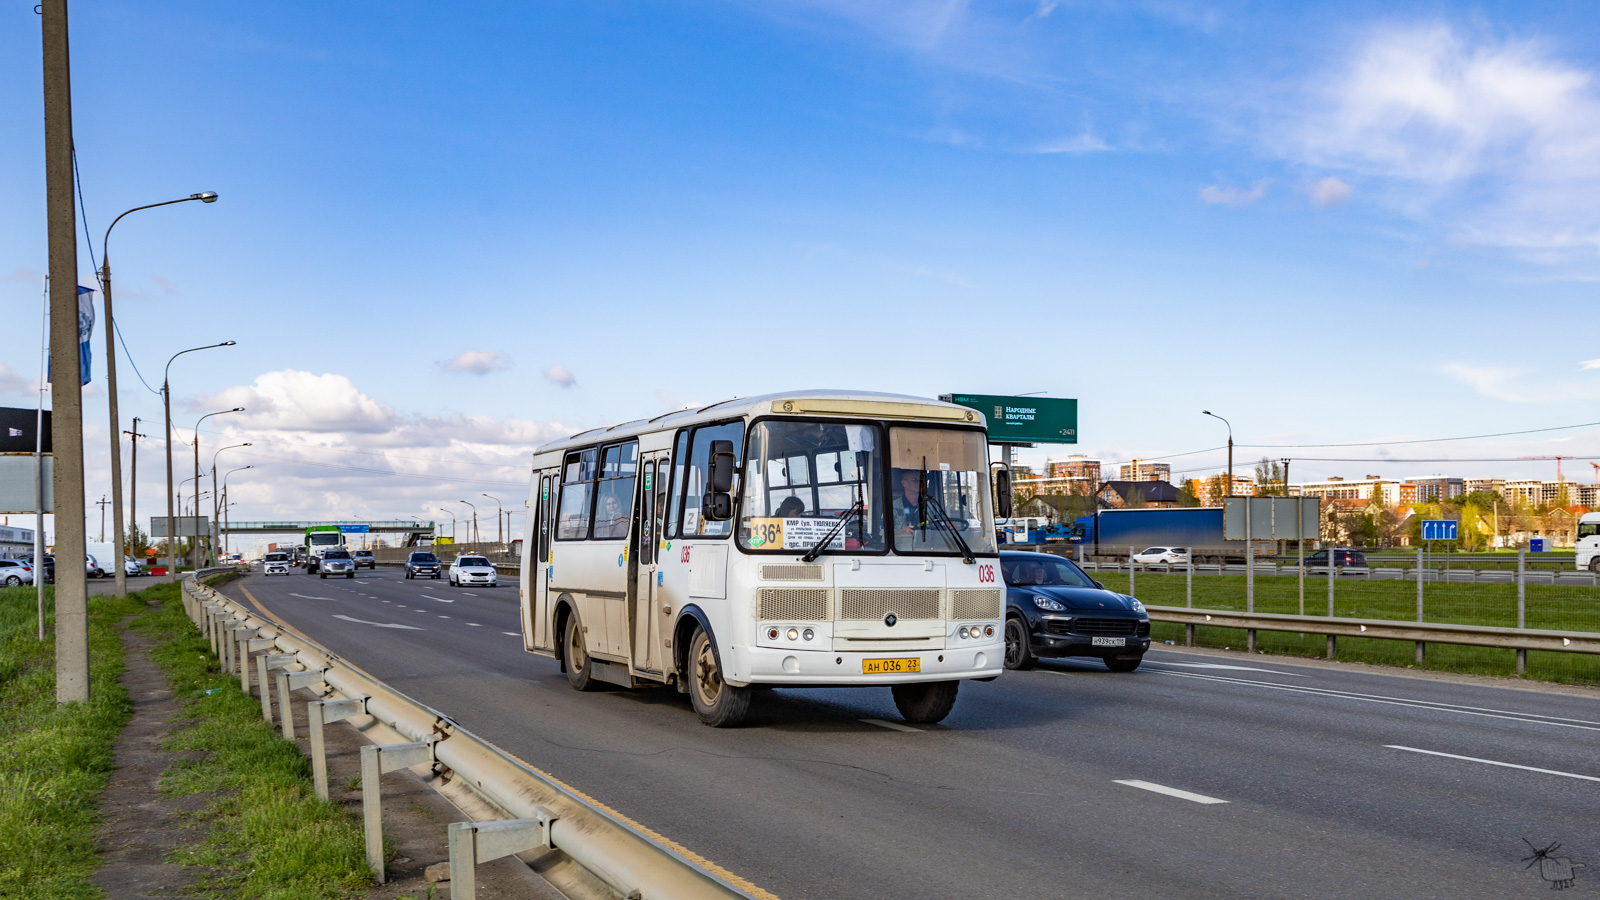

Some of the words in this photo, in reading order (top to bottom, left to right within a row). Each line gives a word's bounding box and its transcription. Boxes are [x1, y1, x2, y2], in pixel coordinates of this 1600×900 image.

[1006, 406, 1036, 414] НАРОДНЫЕ
[979, 564, 995, 583] 036
[883, 661, 902, 671] 036
[907, 659, 917, 668] 23
